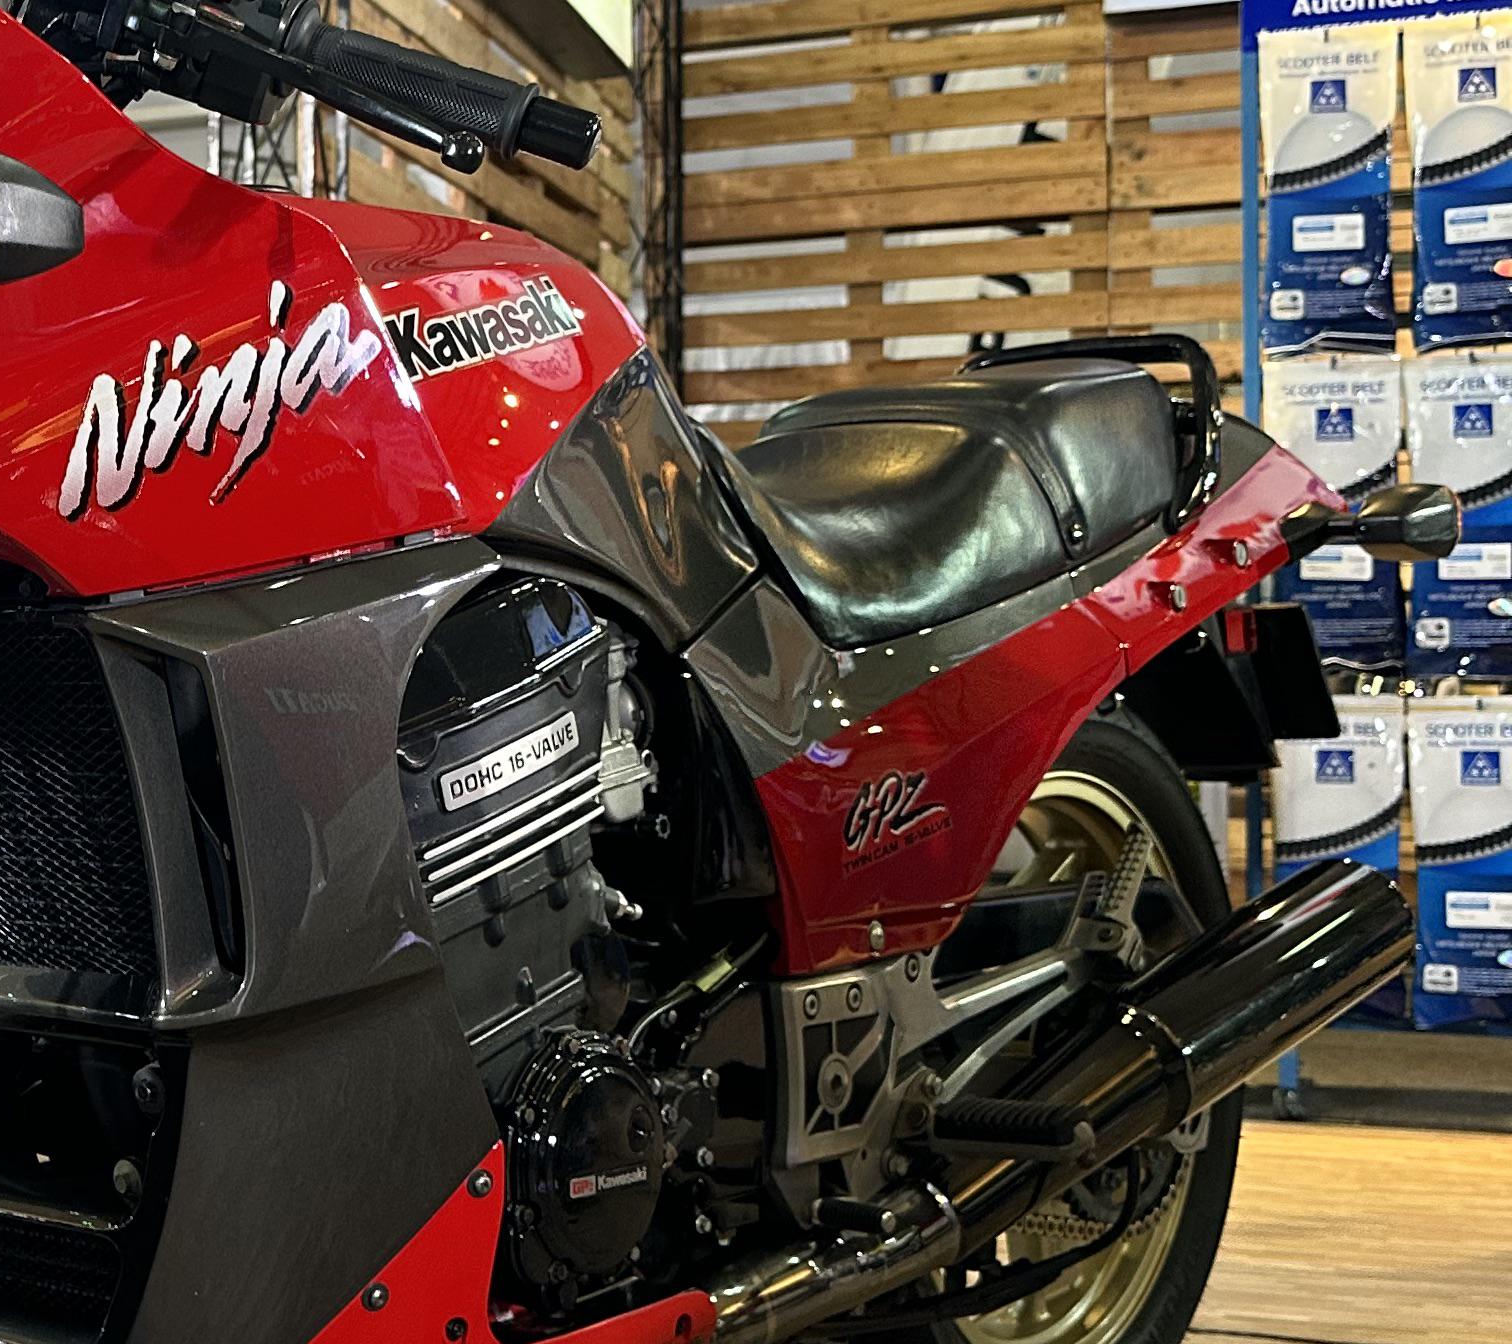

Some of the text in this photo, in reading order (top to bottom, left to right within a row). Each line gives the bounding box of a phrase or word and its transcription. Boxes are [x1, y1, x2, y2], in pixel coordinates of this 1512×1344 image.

[386, 277, 578, 378] Kawasaki
[58, 279, 382, 523] Ninja
[449, 722, 574, 800] DOHC 16-VALVE
